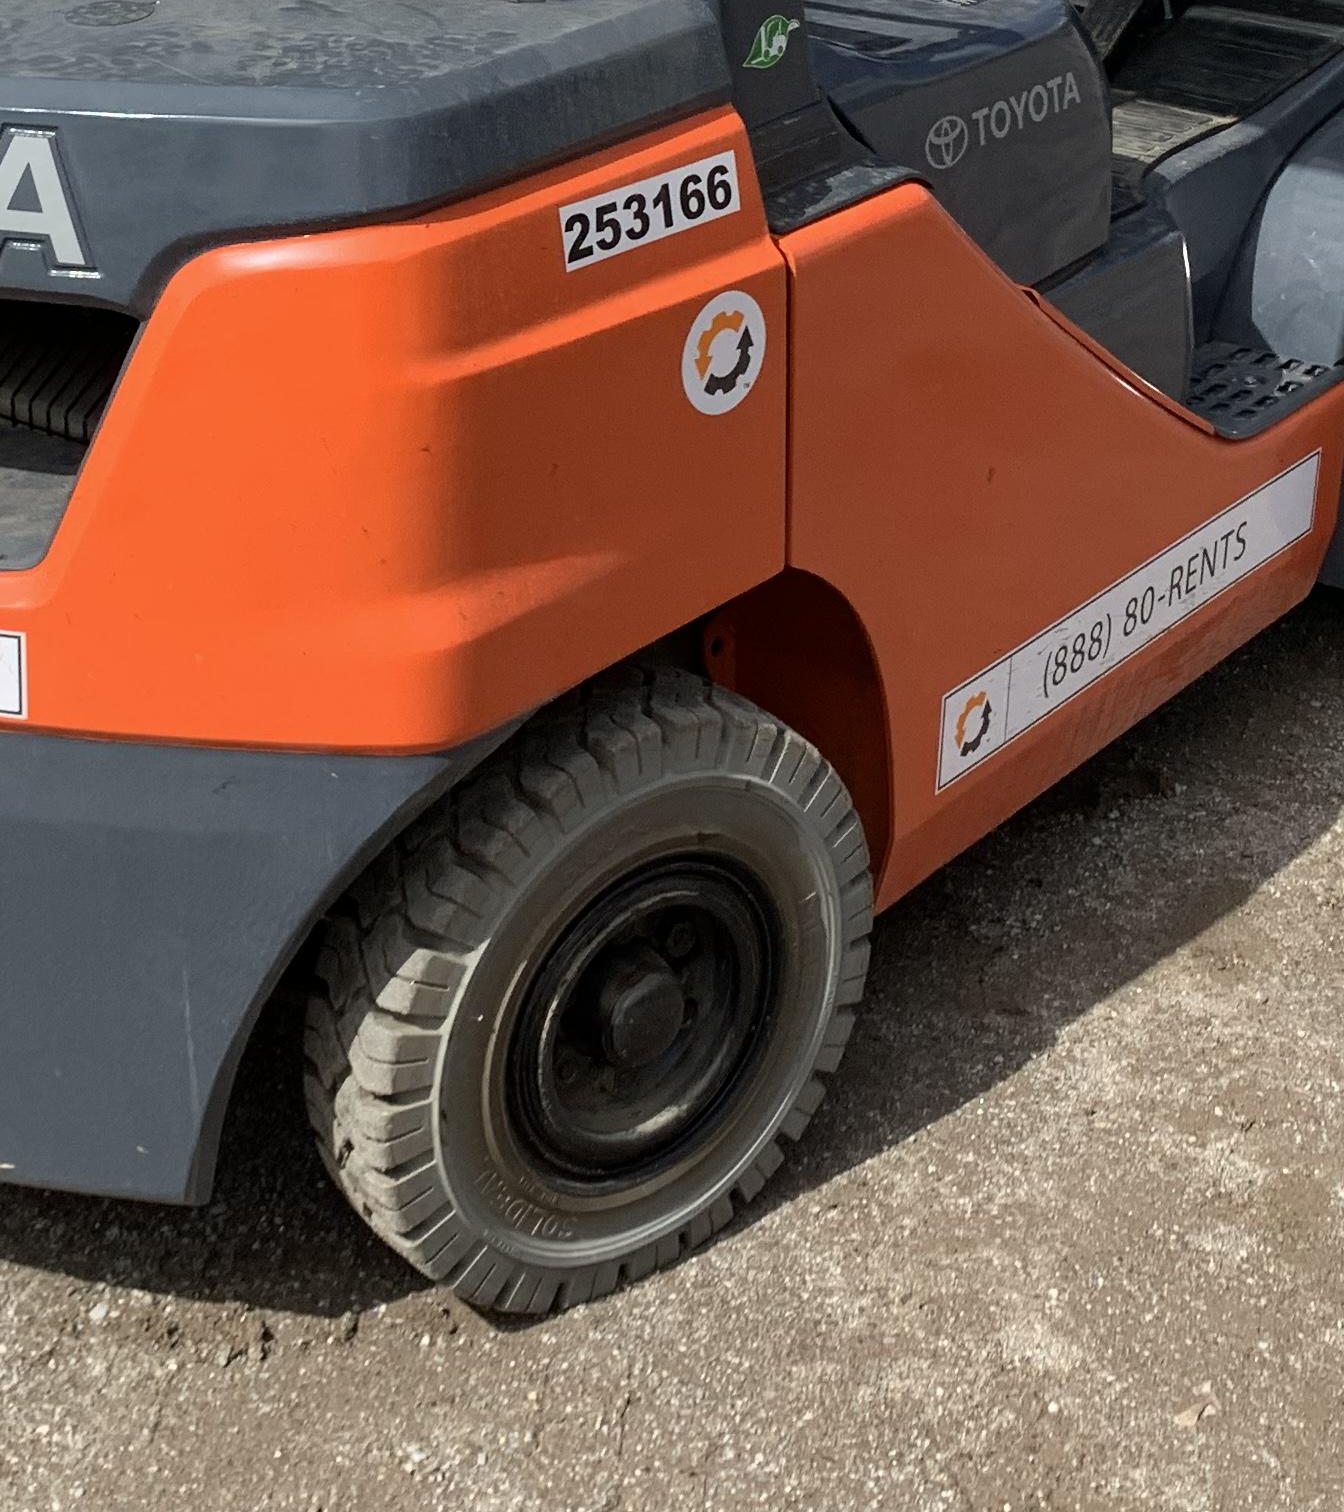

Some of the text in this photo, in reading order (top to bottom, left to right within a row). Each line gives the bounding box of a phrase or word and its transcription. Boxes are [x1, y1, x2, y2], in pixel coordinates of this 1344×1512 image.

[972, 71, 1081, 146] TOYOTA
[564, 164, 732, 264] 253166
[1042, 521, 1248, 699] (888) 80-RENTS
